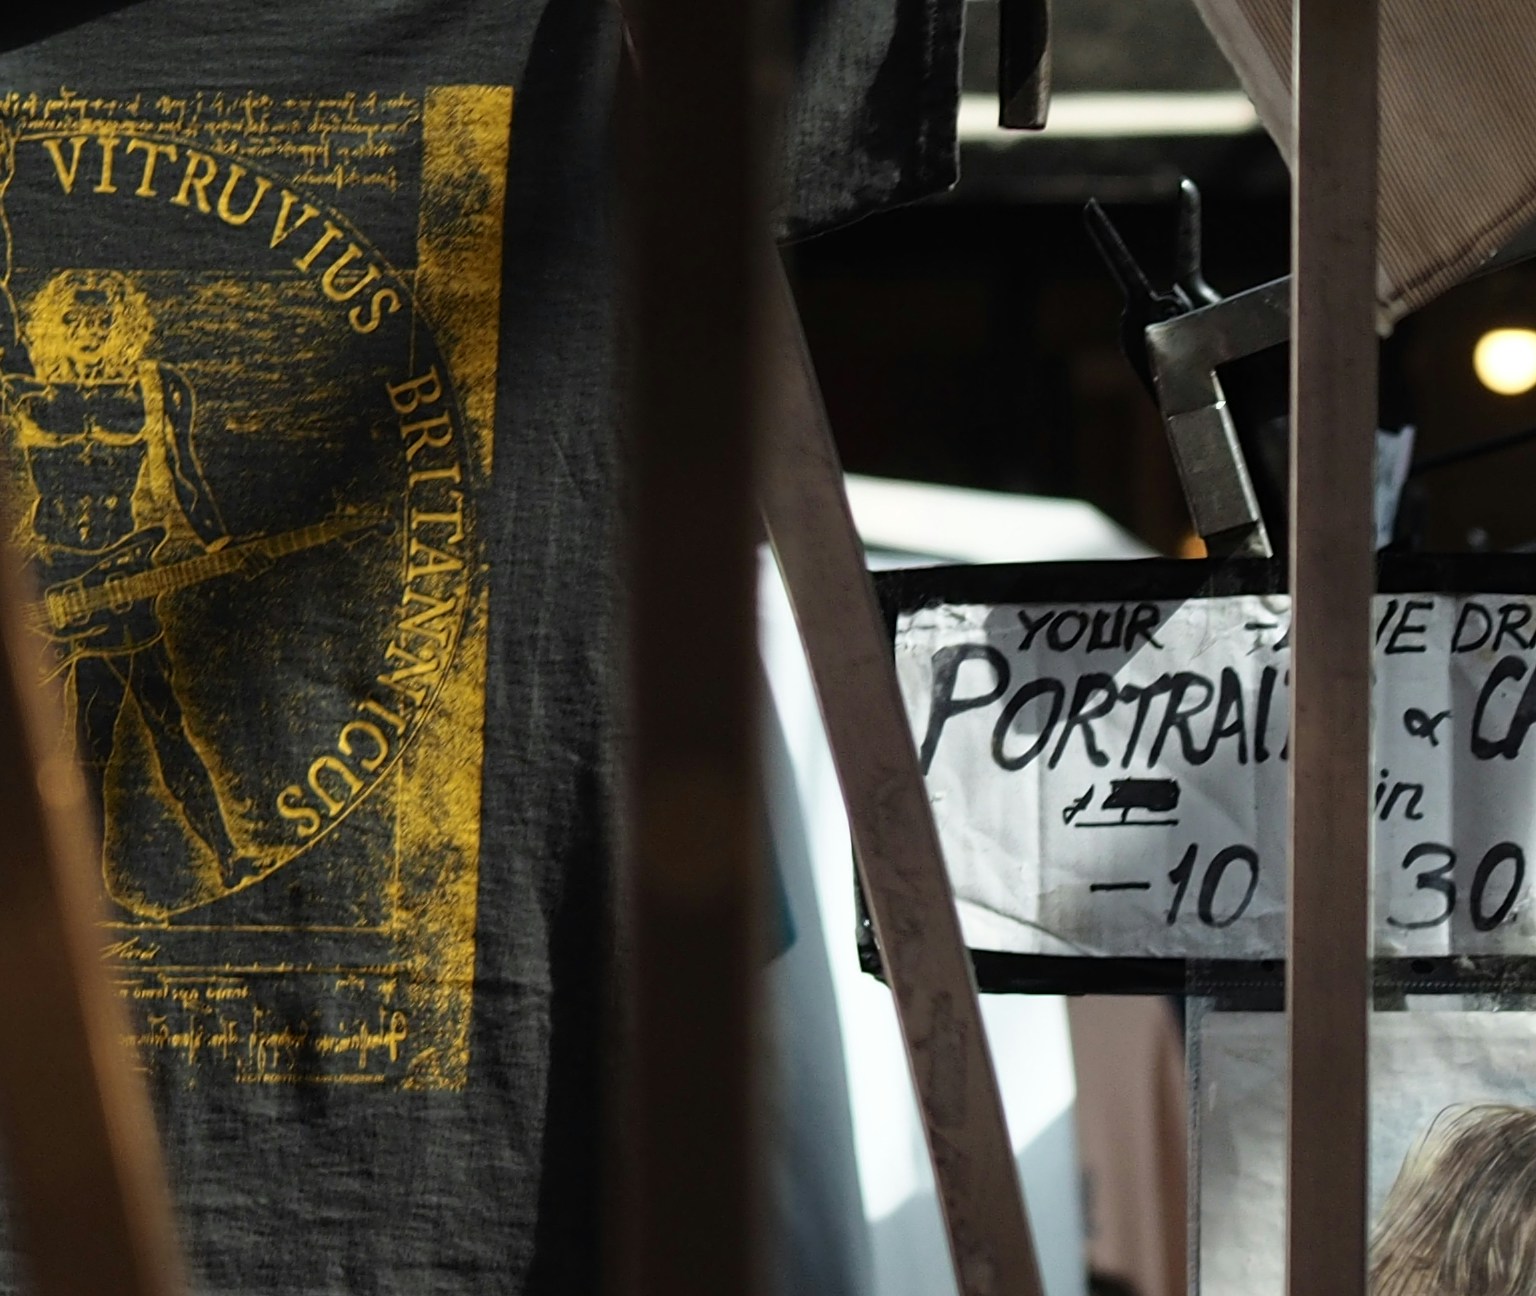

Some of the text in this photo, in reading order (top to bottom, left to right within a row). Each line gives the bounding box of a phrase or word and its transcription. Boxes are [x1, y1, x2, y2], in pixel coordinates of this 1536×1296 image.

[43, 135, 403, 335] VITRUVIUS
[276, 364, 467, 837] BRITANNICUS
[1017, 602, 1164, 652] YOUR
[920, 643, 1290, 776] PORTRAI
[1387, 842, 1526, 931] 30
